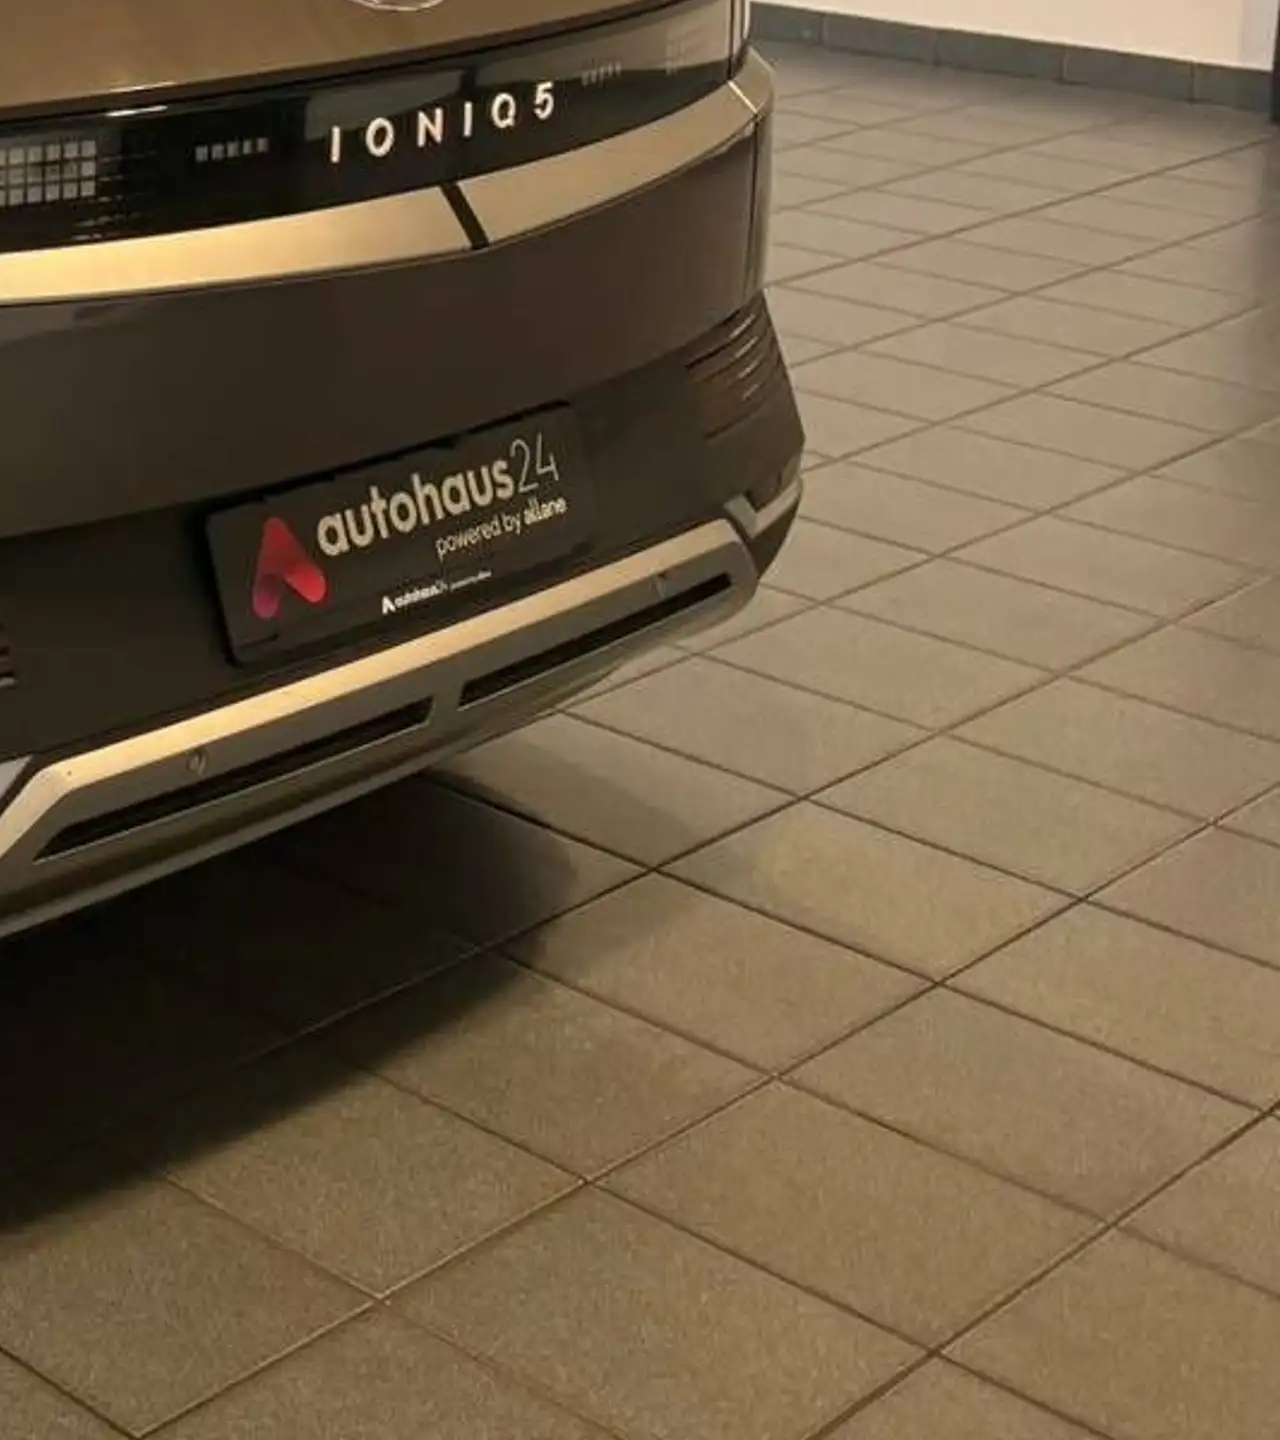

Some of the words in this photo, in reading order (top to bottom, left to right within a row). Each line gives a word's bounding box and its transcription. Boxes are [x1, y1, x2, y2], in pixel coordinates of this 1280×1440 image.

[317, 432, 559, 556] autohaus24
[435, 514, 501, 561] powered
[502, 511, 522, 534] by
